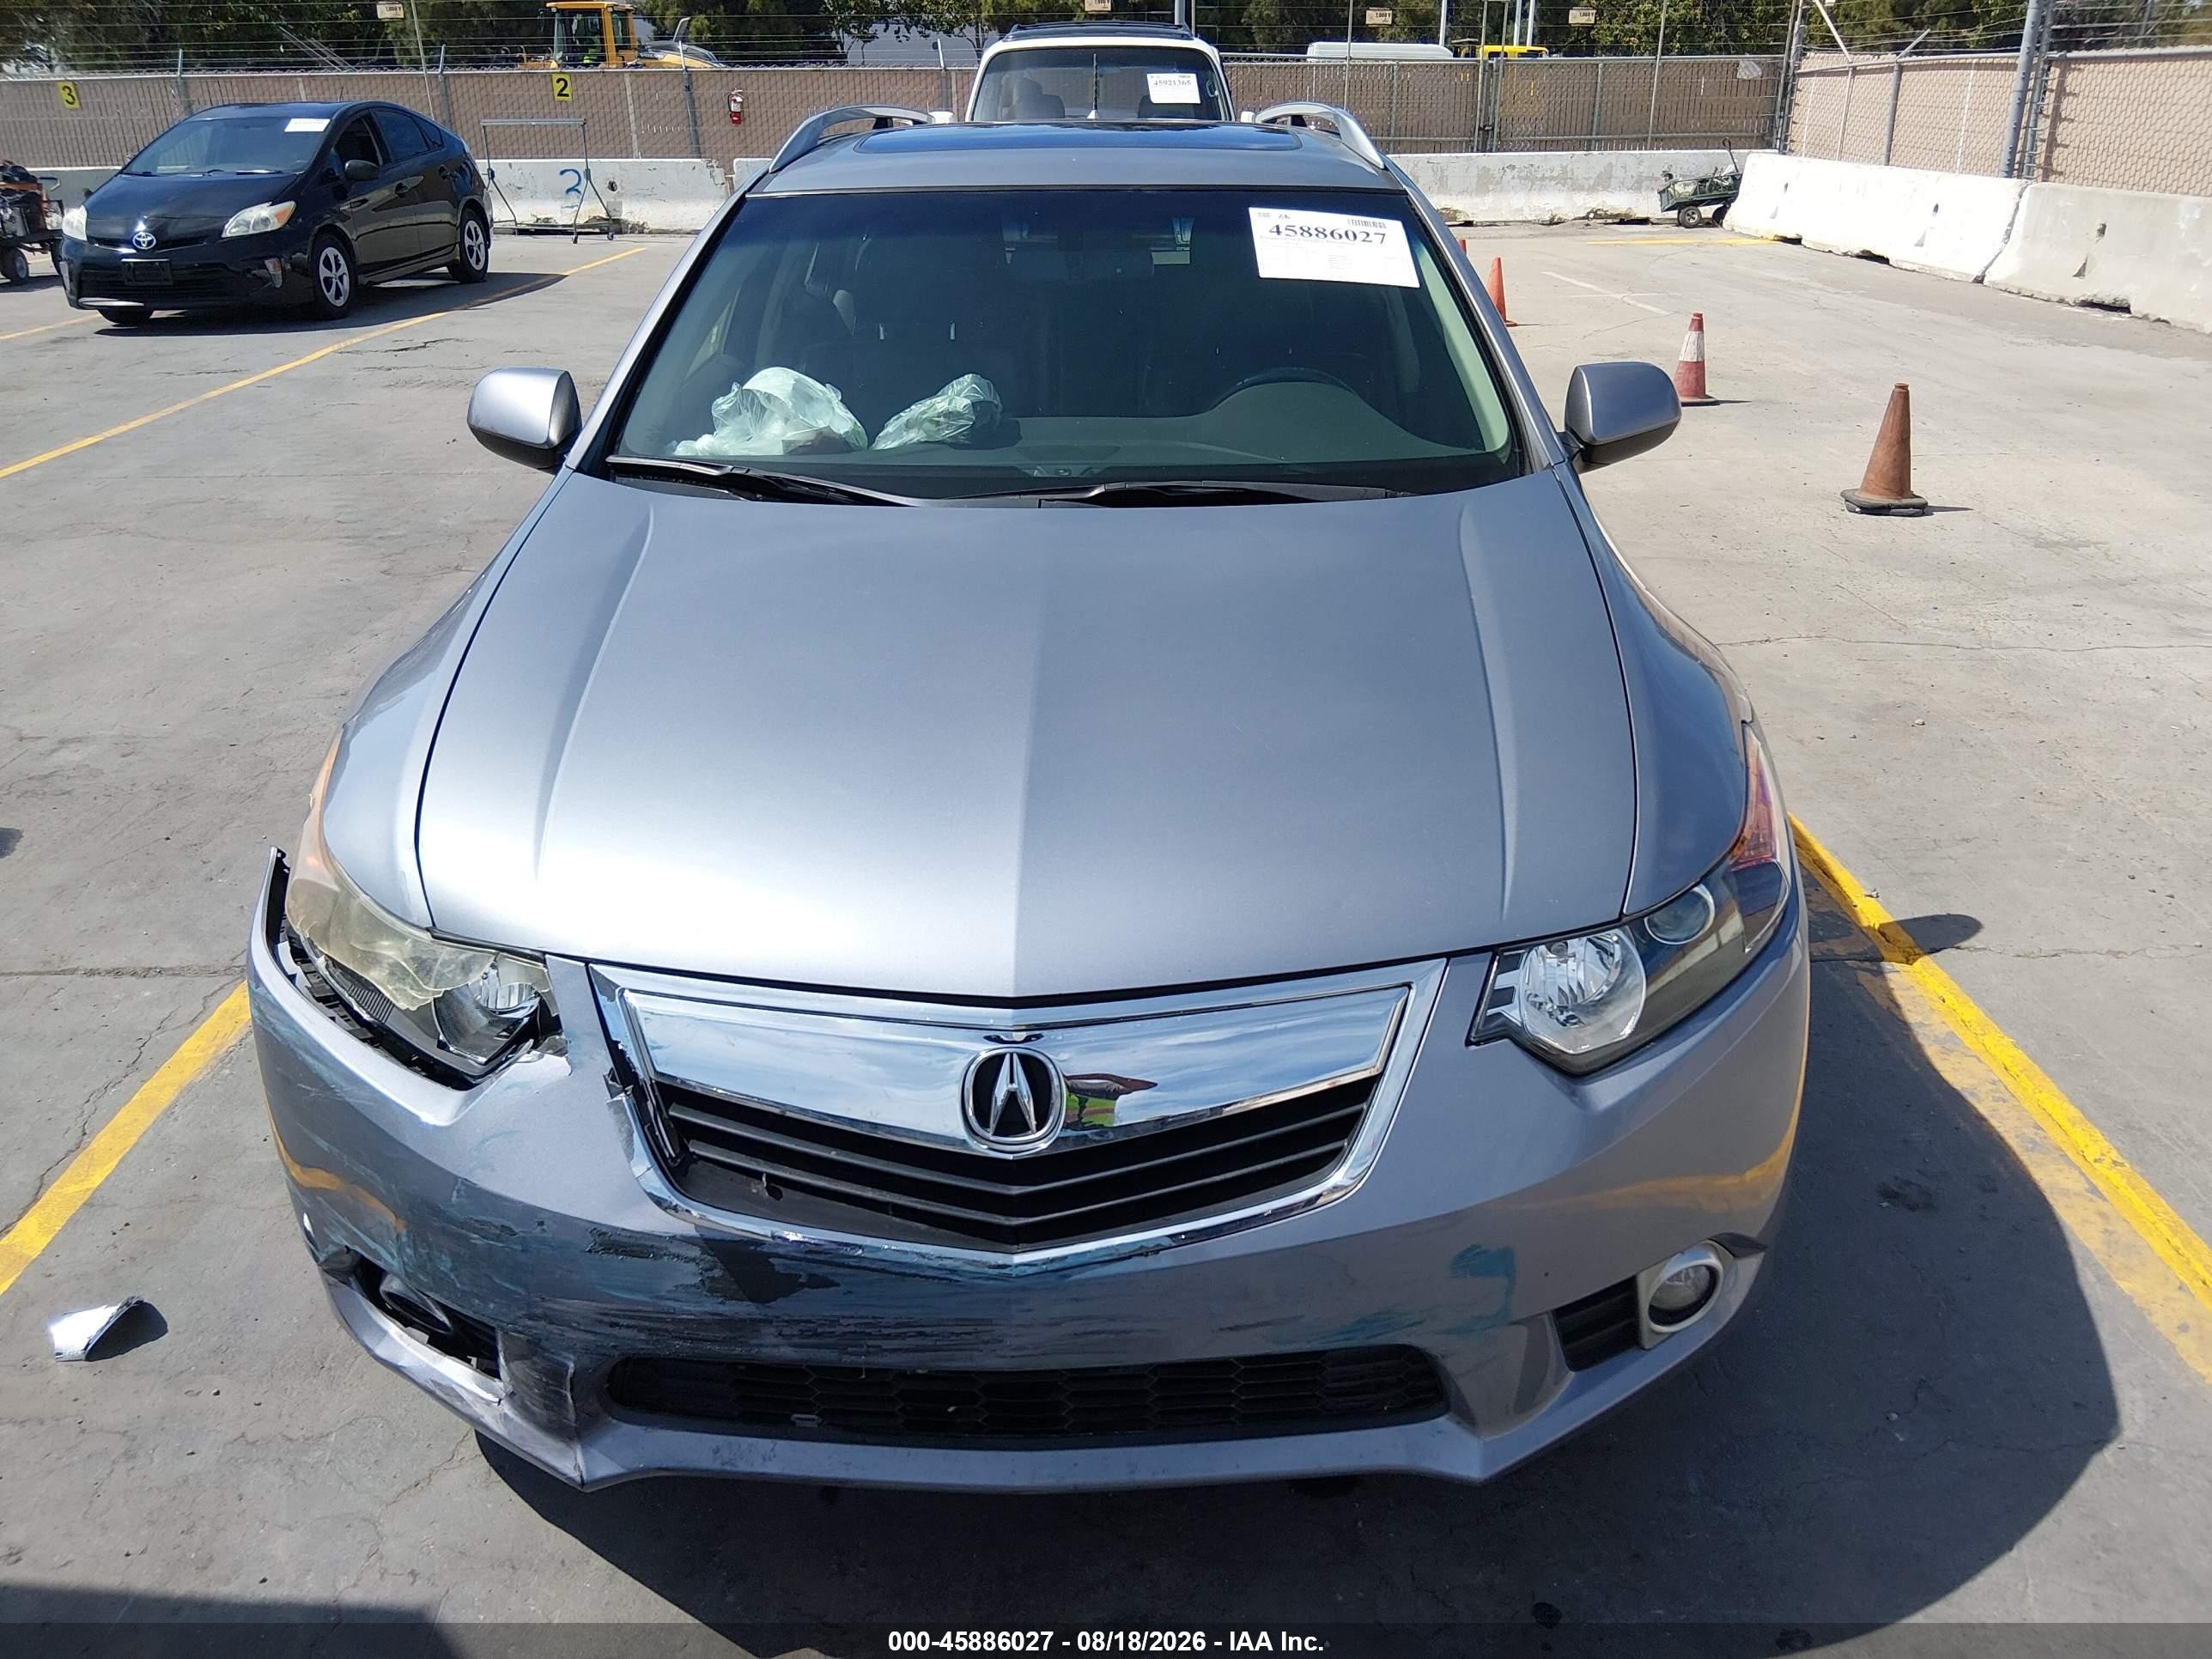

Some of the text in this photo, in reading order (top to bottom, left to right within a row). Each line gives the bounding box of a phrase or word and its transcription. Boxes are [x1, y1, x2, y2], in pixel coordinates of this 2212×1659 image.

[62, 85, 76, 105] 3
[556, 77, 568, 97] 2
[560, 168, 581, 196] 2
[1269, 224, 1386, 245] 45886027
